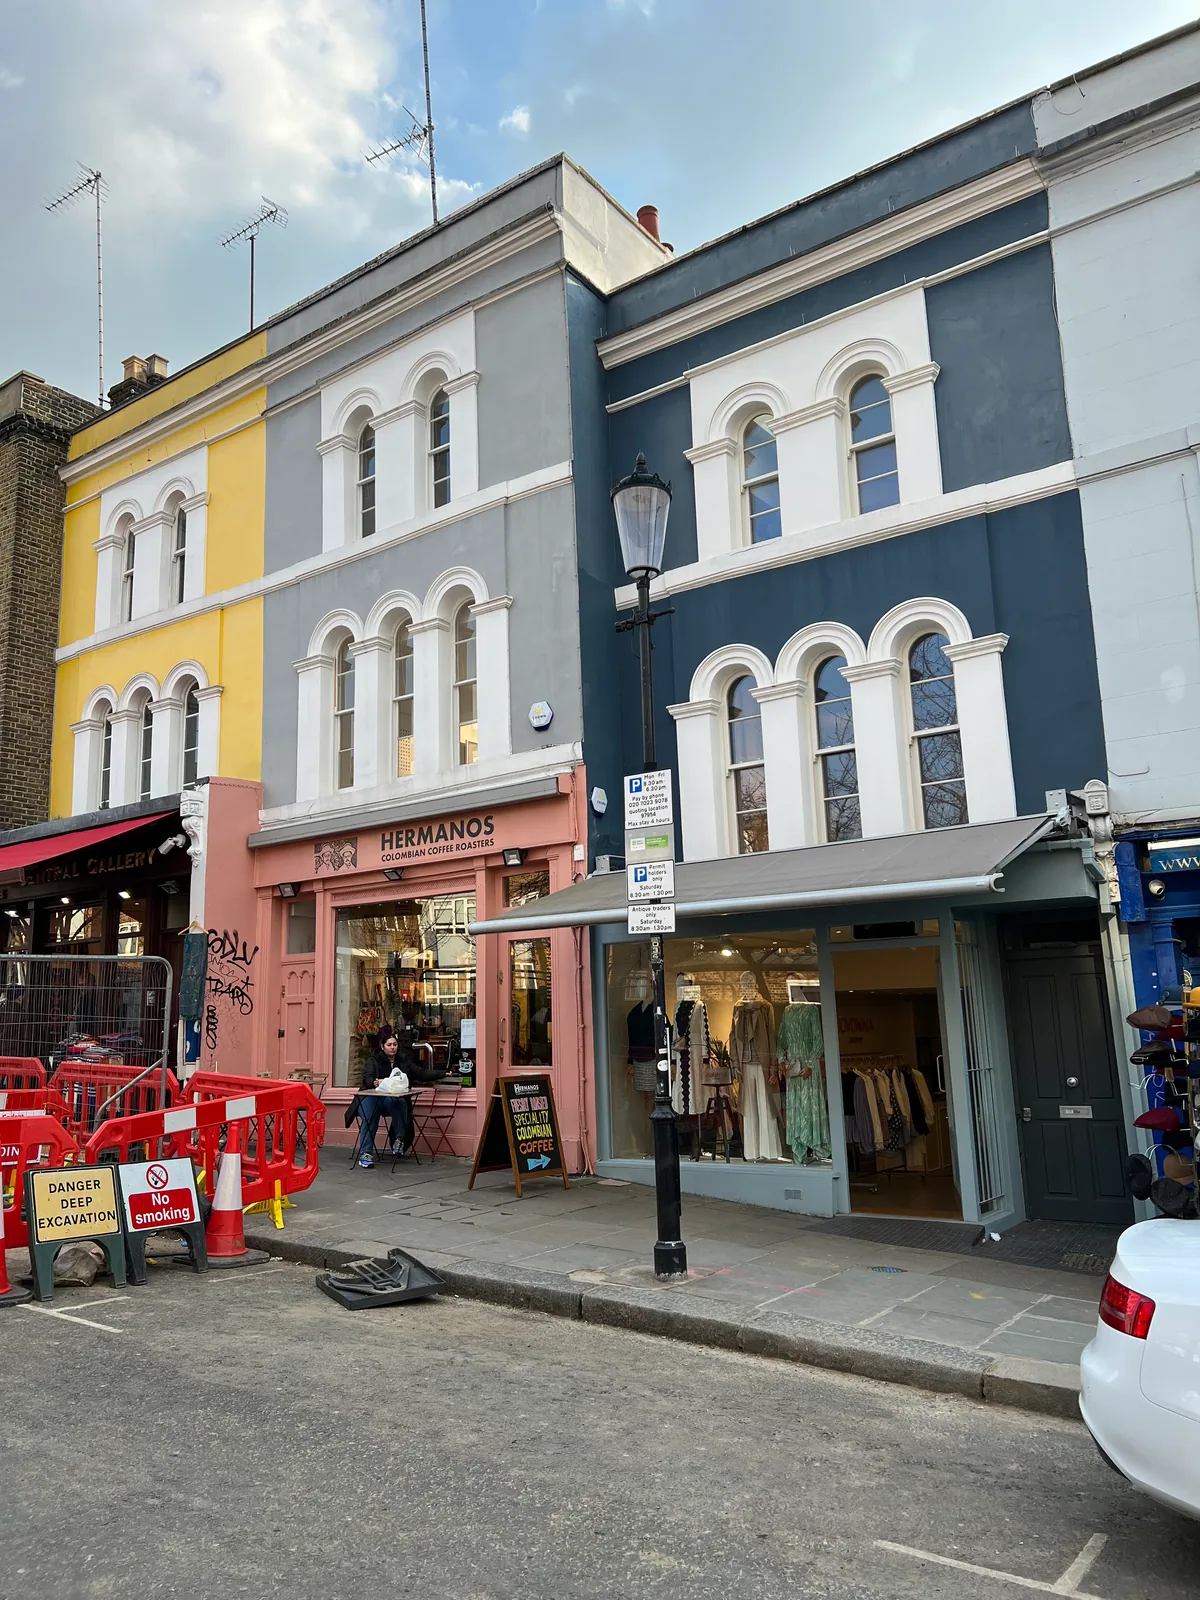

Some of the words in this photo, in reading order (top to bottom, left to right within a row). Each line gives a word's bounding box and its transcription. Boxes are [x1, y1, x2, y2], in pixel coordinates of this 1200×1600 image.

[381, 815, 495, 851] HERMANOS
[381, 849, 425, 862] COLOMBIAN
[428, 845, 453, 855] COFFEE
[456, 838, 495, 851] ROASTERS
[25, 862, 79, 885] ENTRAL
[87, 848, 156, 874] GALLERY
[514, 1110, 548, 1126] SPECIALITY
[516, 1124, 552, 1140] COLOMBIAN
[519, 1139, 554, 1154] COFFEE
[49, 1179, 101, 1194] DANGER
[61, 1196, 93, 1209] DEEP
[151, 1193, 169, 1206] No
[38, 1210, 116, 1229] EXCAVATION
[135, 1207, 190, 1225] smoking
